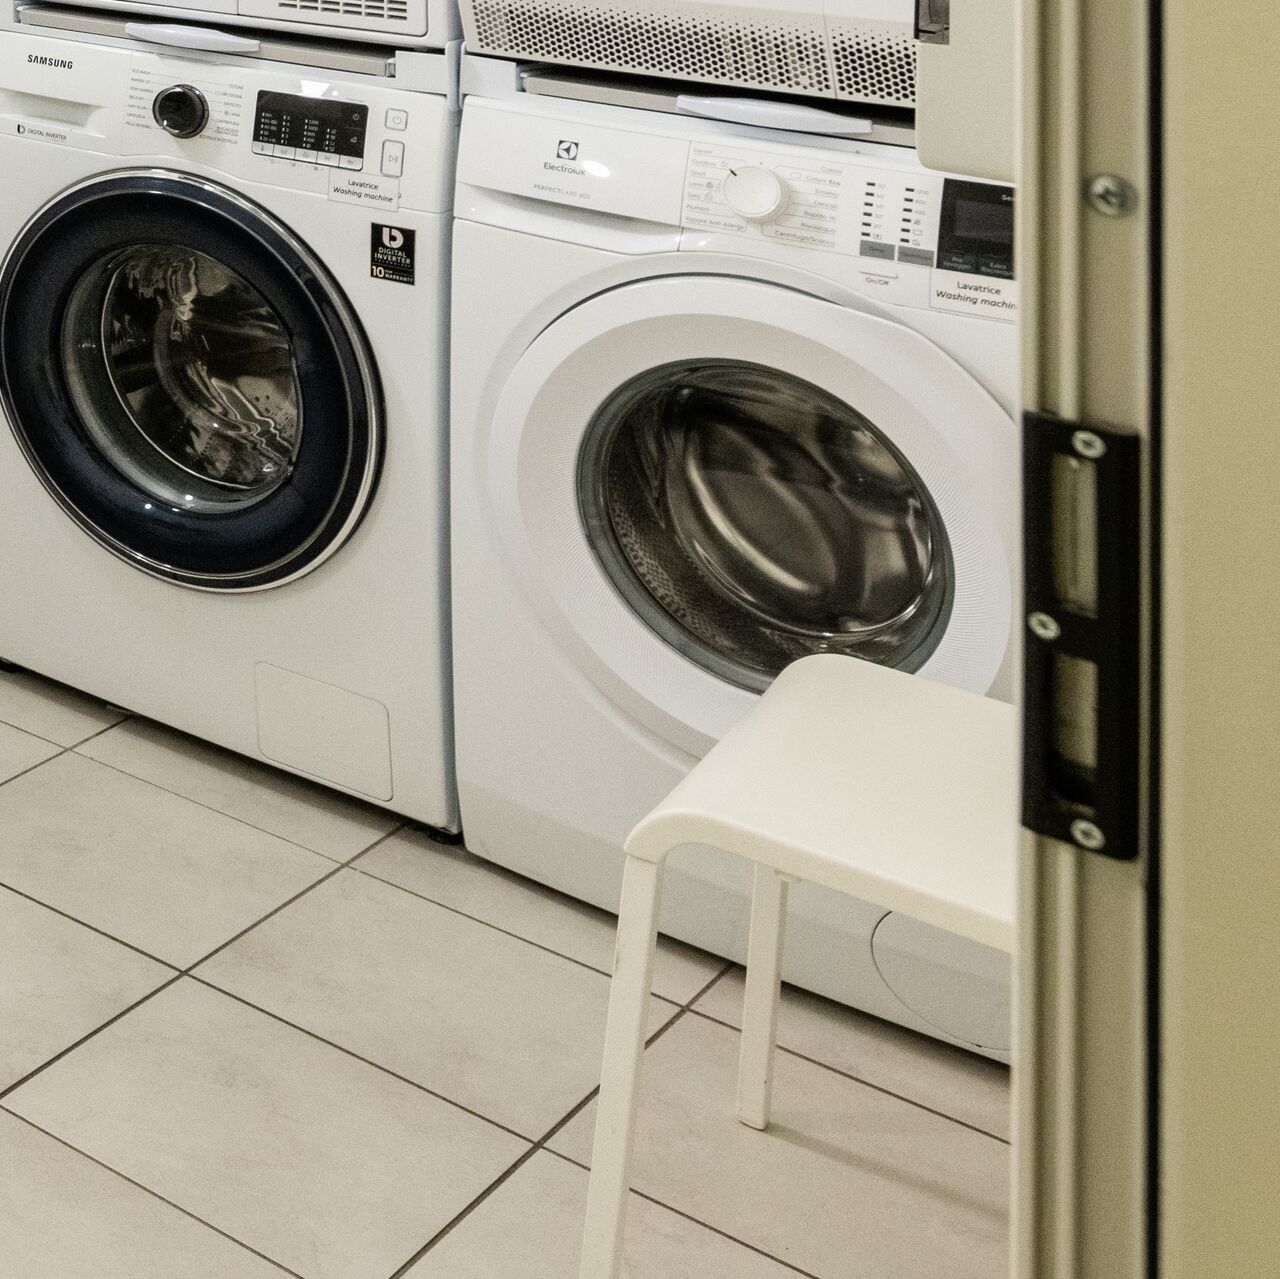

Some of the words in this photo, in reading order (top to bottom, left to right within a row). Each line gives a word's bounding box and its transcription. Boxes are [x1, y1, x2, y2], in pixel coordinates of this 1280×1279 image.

[27, 54, 73, 70] SAMSUNG
[27, 128, 44, 136] DIGITAL
[45, 131, 67, 140] INVERTER
[544, 161, 586, 176] Electrolux
[348, 178, 379, 190] Lavatrice
[533, 183, 578, 197] PERFECTCARE
[333, 186, 362, 198] Washing
[363, 193, 393, 203] machine
[374, 252, 411, 265] INVERTER
[378, 247, 407, 258] DIGITAL
[371, 265, 384, 278] 10
[385, 273, 414, 283] WARRANTY
[865, 277, 889, 286] On/Off
[957, 281, 1001, 295] Lavatrice
[936, 289, 978, 305] Washing
[980, 298, 1017, 310] machin
